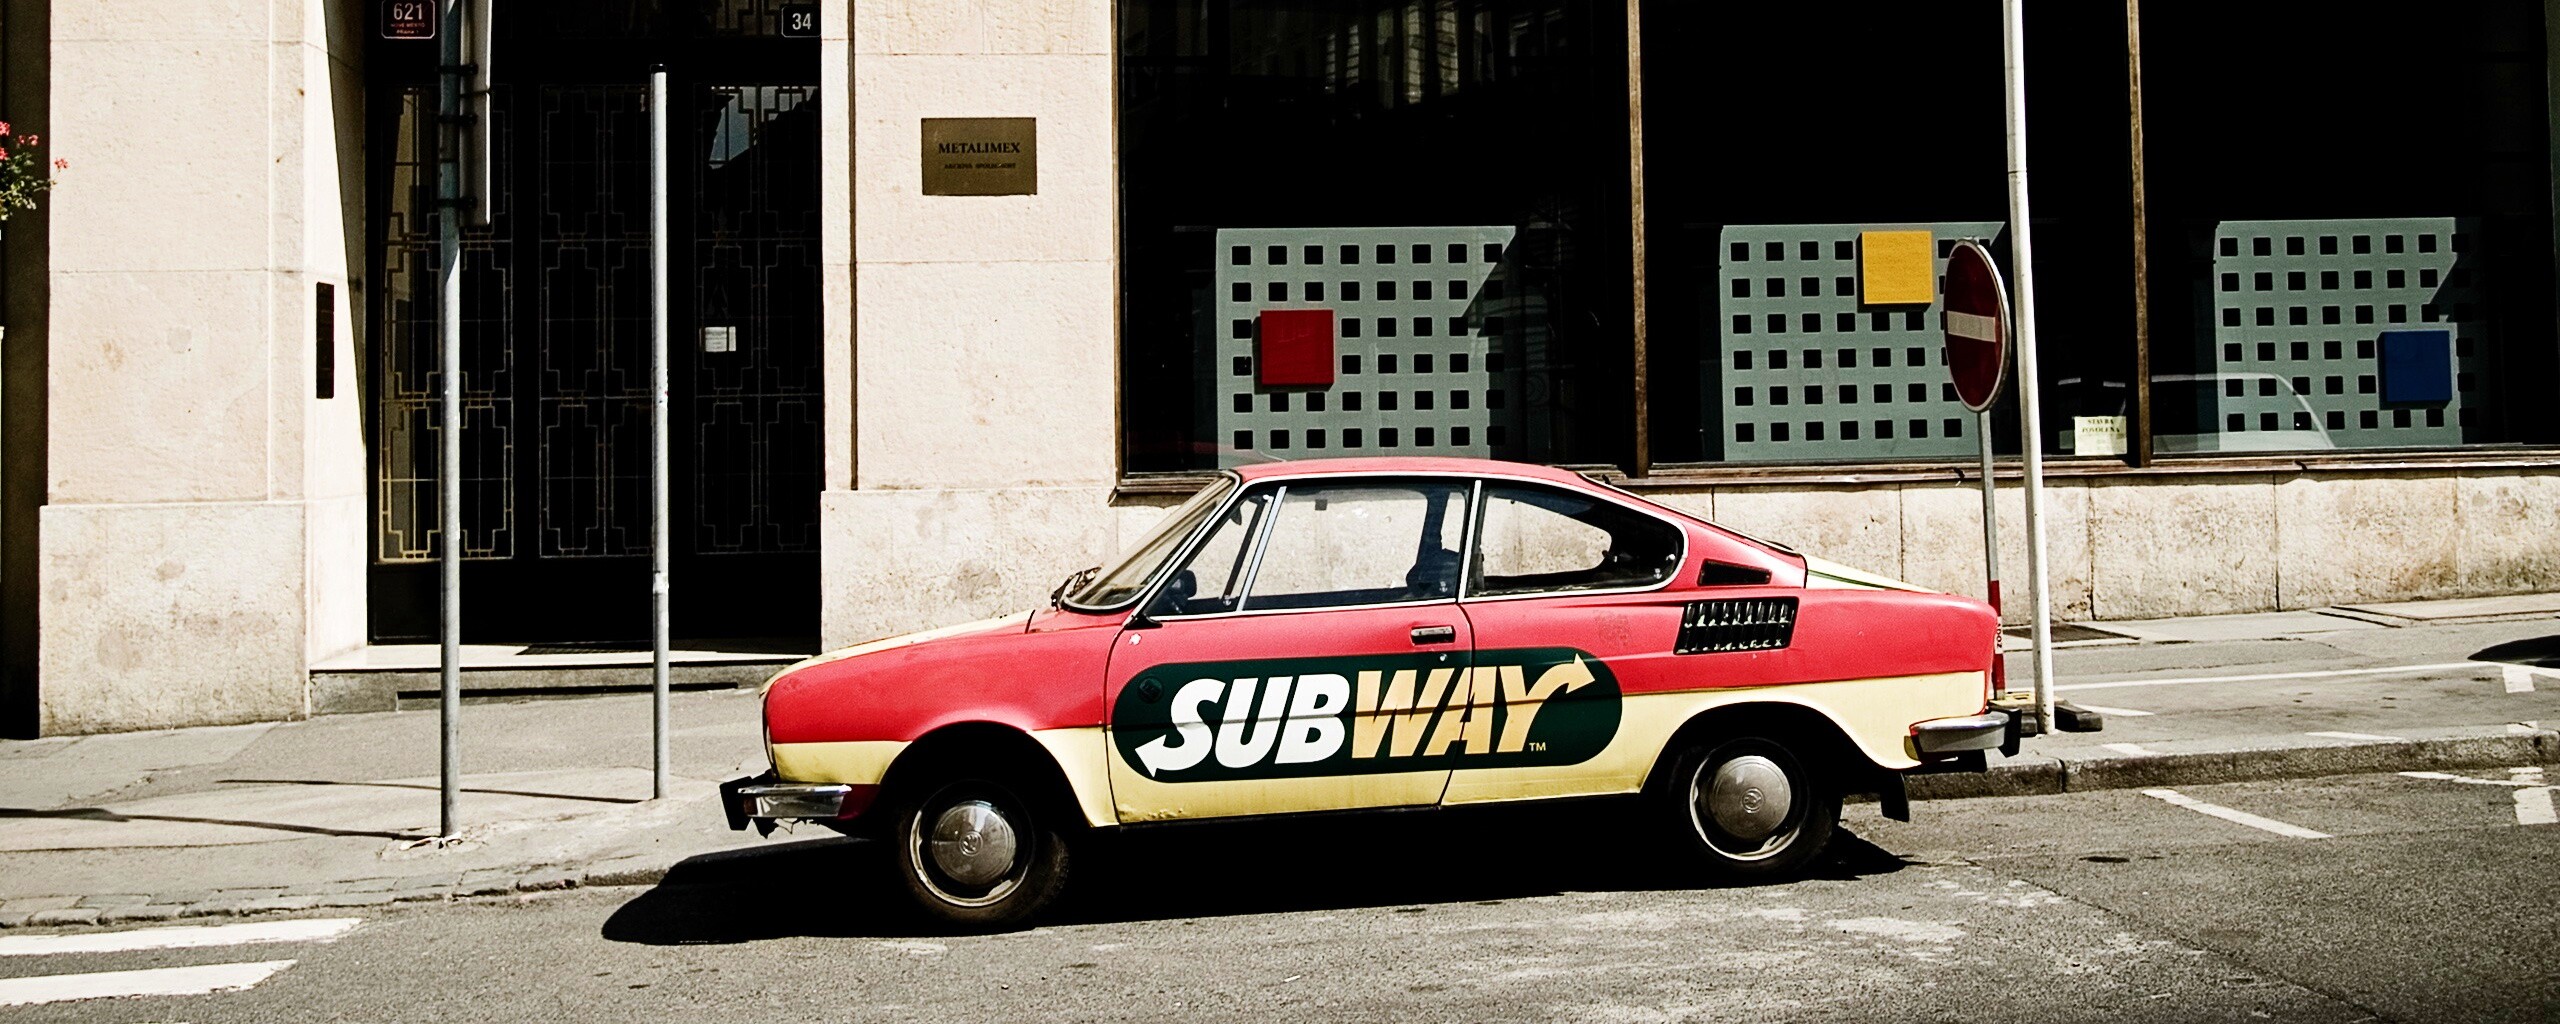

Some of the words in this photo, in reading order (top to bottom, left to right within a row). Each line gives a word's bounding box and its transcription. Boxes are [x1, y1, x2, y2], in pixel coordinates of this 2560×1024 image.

[393, 2, 423, 20] 621
[792, 12, 812, 30] 34
[938, 142, 1021, 154] METALIMEX
[1135, 653, 1596, 778] SUBWAY
[1528, 741, 1547, 752] TM
